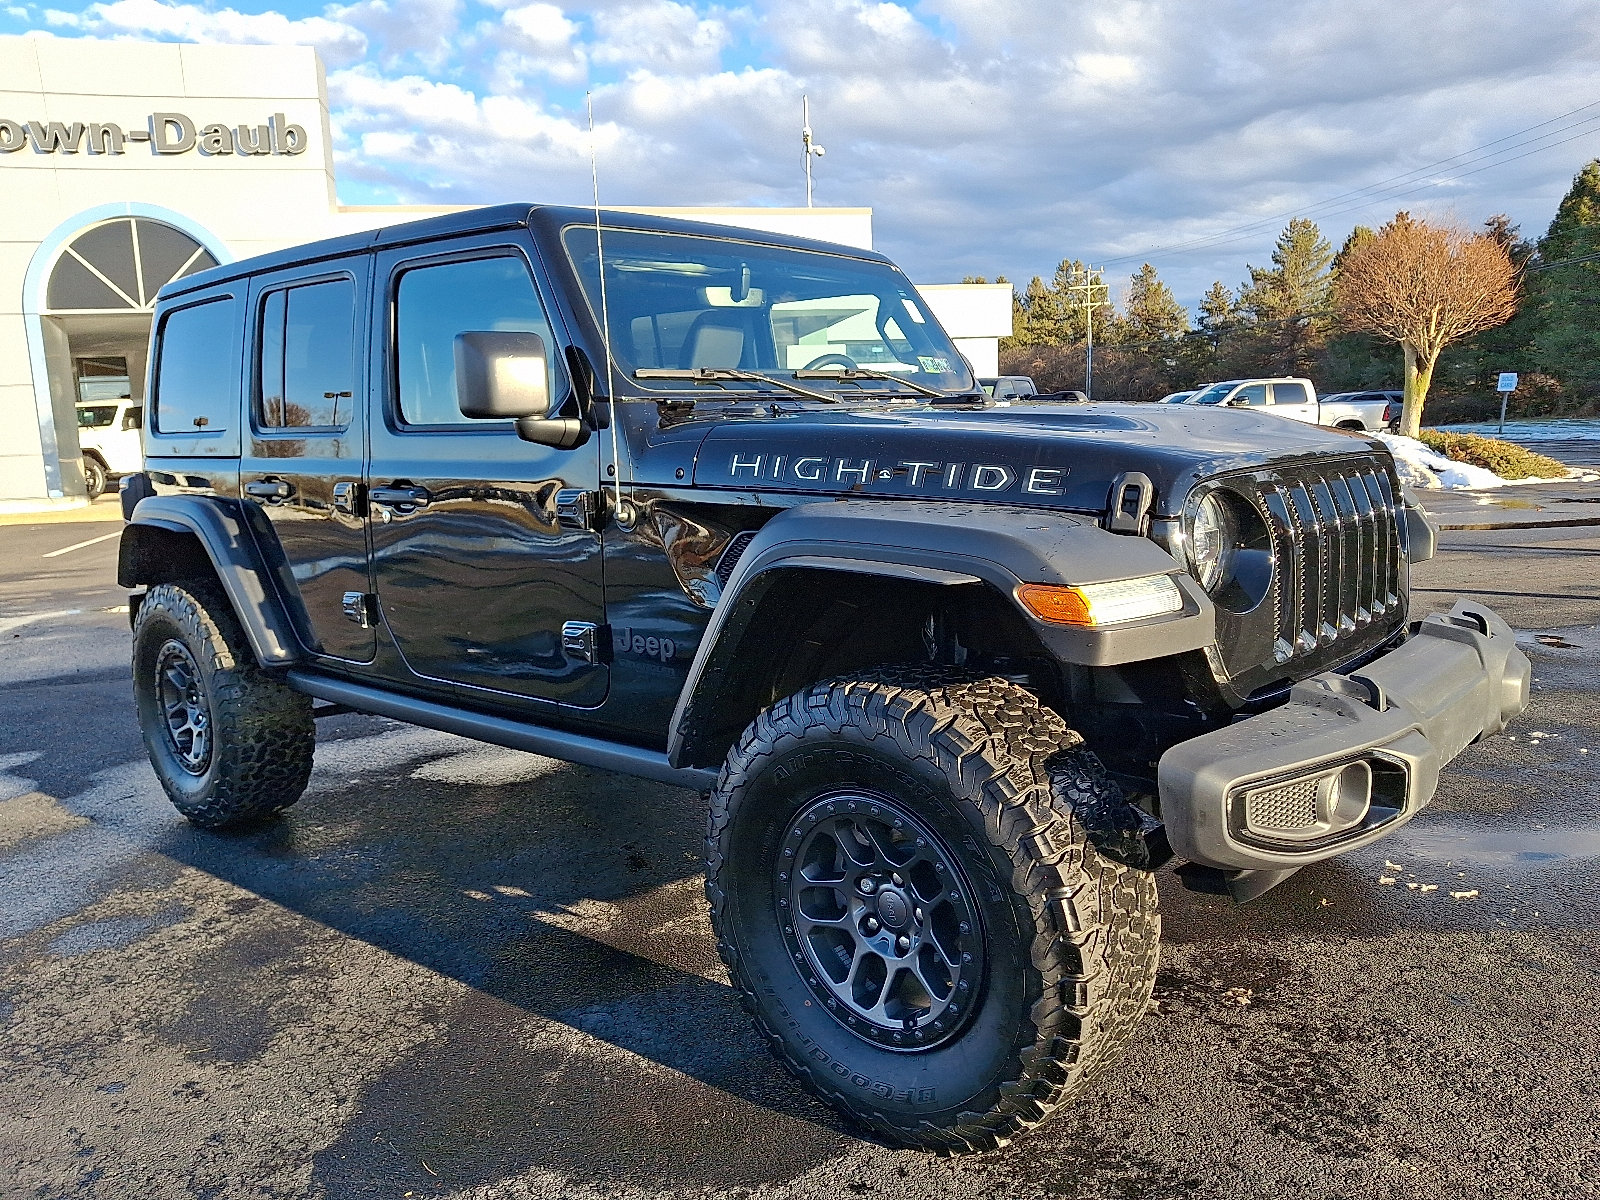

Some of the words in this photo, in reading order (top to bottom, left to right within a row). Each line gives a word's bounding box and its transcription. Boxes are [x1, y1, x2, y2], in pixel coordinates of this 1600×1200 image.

[729, 452, 877, 485] HIGH
[898, 459, 1072, 496] TIDE
[617, 626, 676, 662] Jeep
